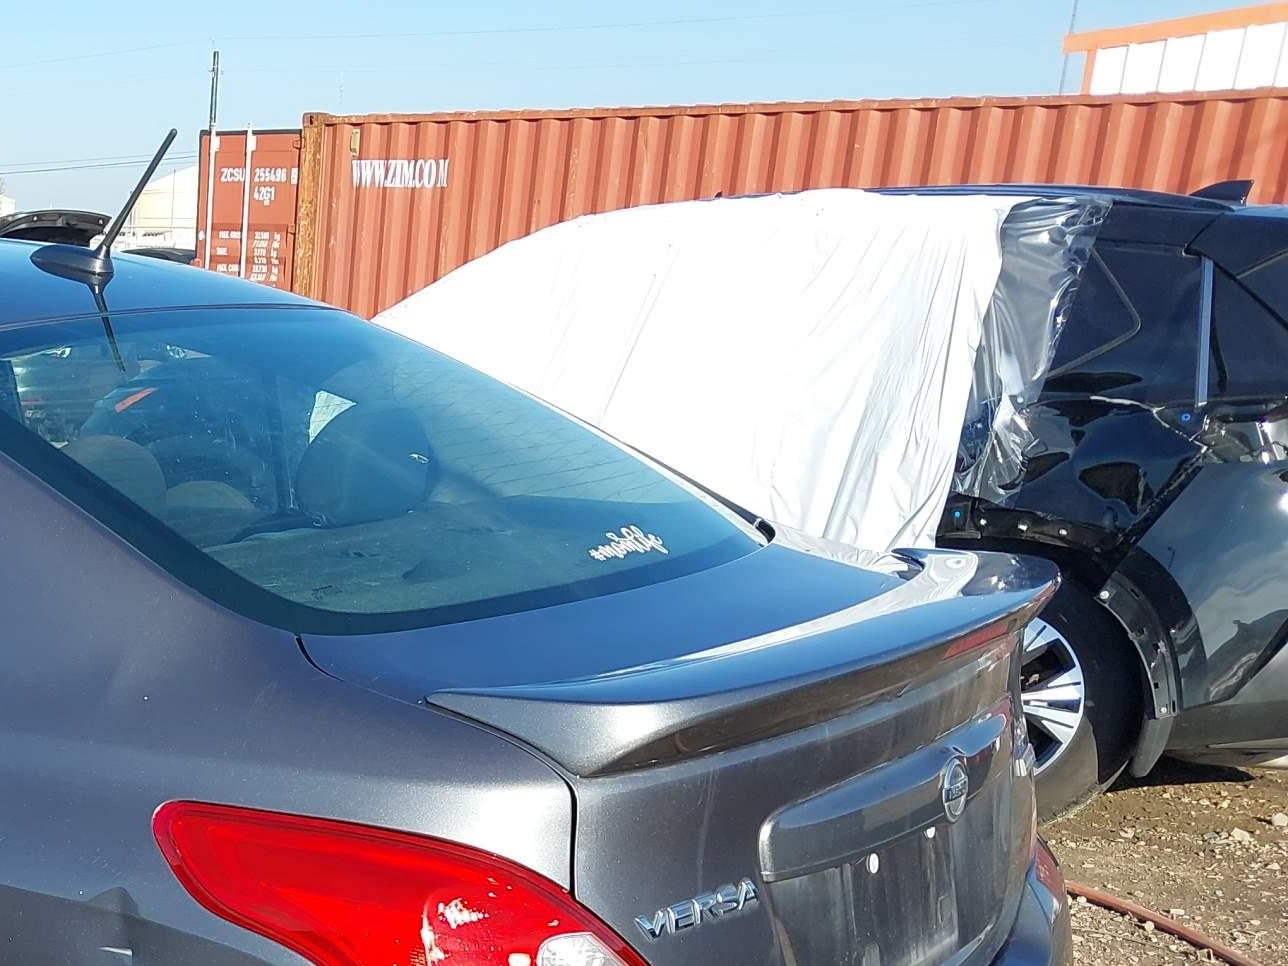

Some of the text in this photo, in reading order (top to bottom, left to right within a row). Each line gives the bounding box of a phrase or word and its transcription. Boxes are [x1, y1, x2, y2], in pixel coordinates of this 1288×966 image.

[220, 167, 245, 182] ZCSU
[253, 186, 275, 201] 42G1
[634, 879, 759, 938] VERSA
